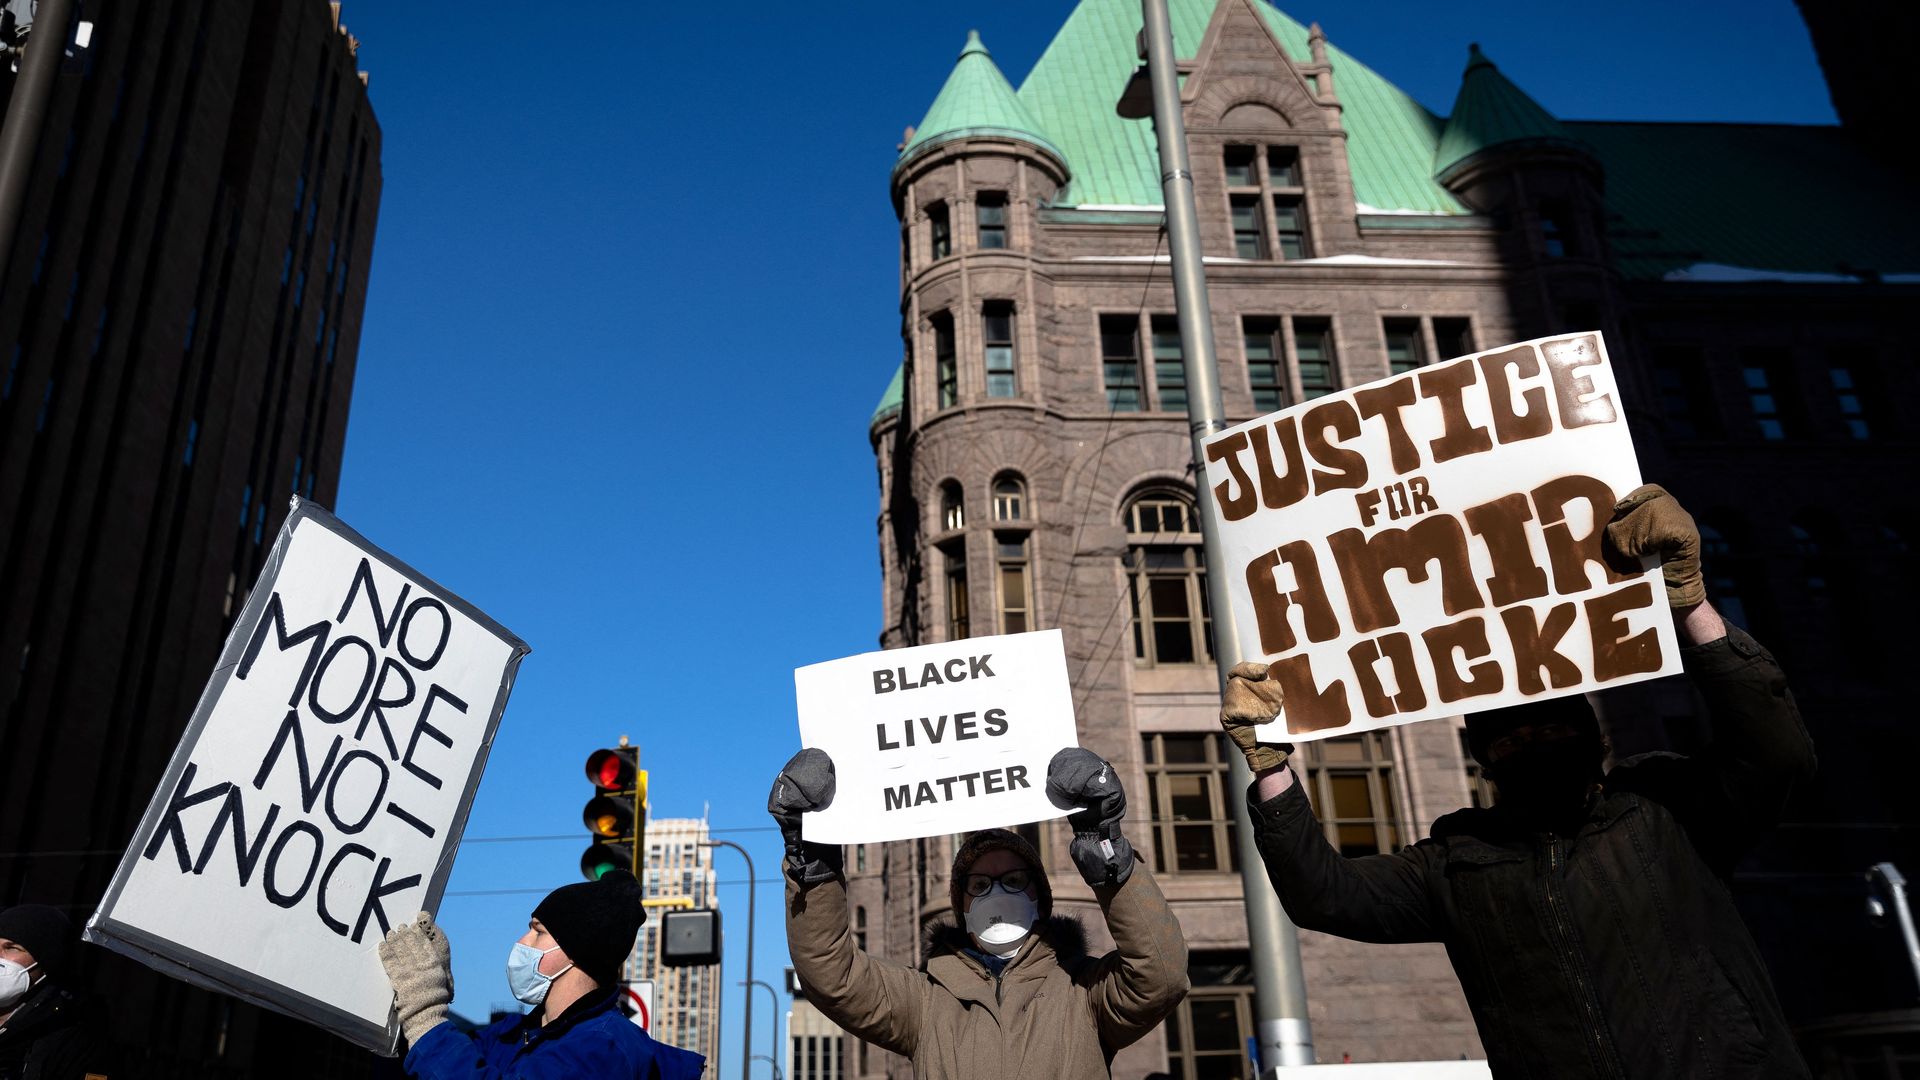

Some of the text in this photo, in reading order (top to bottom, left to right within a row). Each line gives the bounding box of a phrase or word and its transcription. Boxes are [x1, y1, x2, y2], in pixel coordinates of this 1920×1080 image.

[1206, 334, 1617, 521] JUSTICE
[1246, 474, 1643, 655] AMIR
[1355, 476, 1438, 527] FOR
[336, 558, 451, 671] NO
[873, 654, 995, 694] BLACK
[1268, 582, 1662, 734] LOCKE
[236, 592, 468, 790] MORE
[877, 708, 1009, 751] LIVES
[253, 709, 435, 838] NO-
[884, 765, 1031, 811] MATTER
[143, 762, 422, 944] KNOCK
